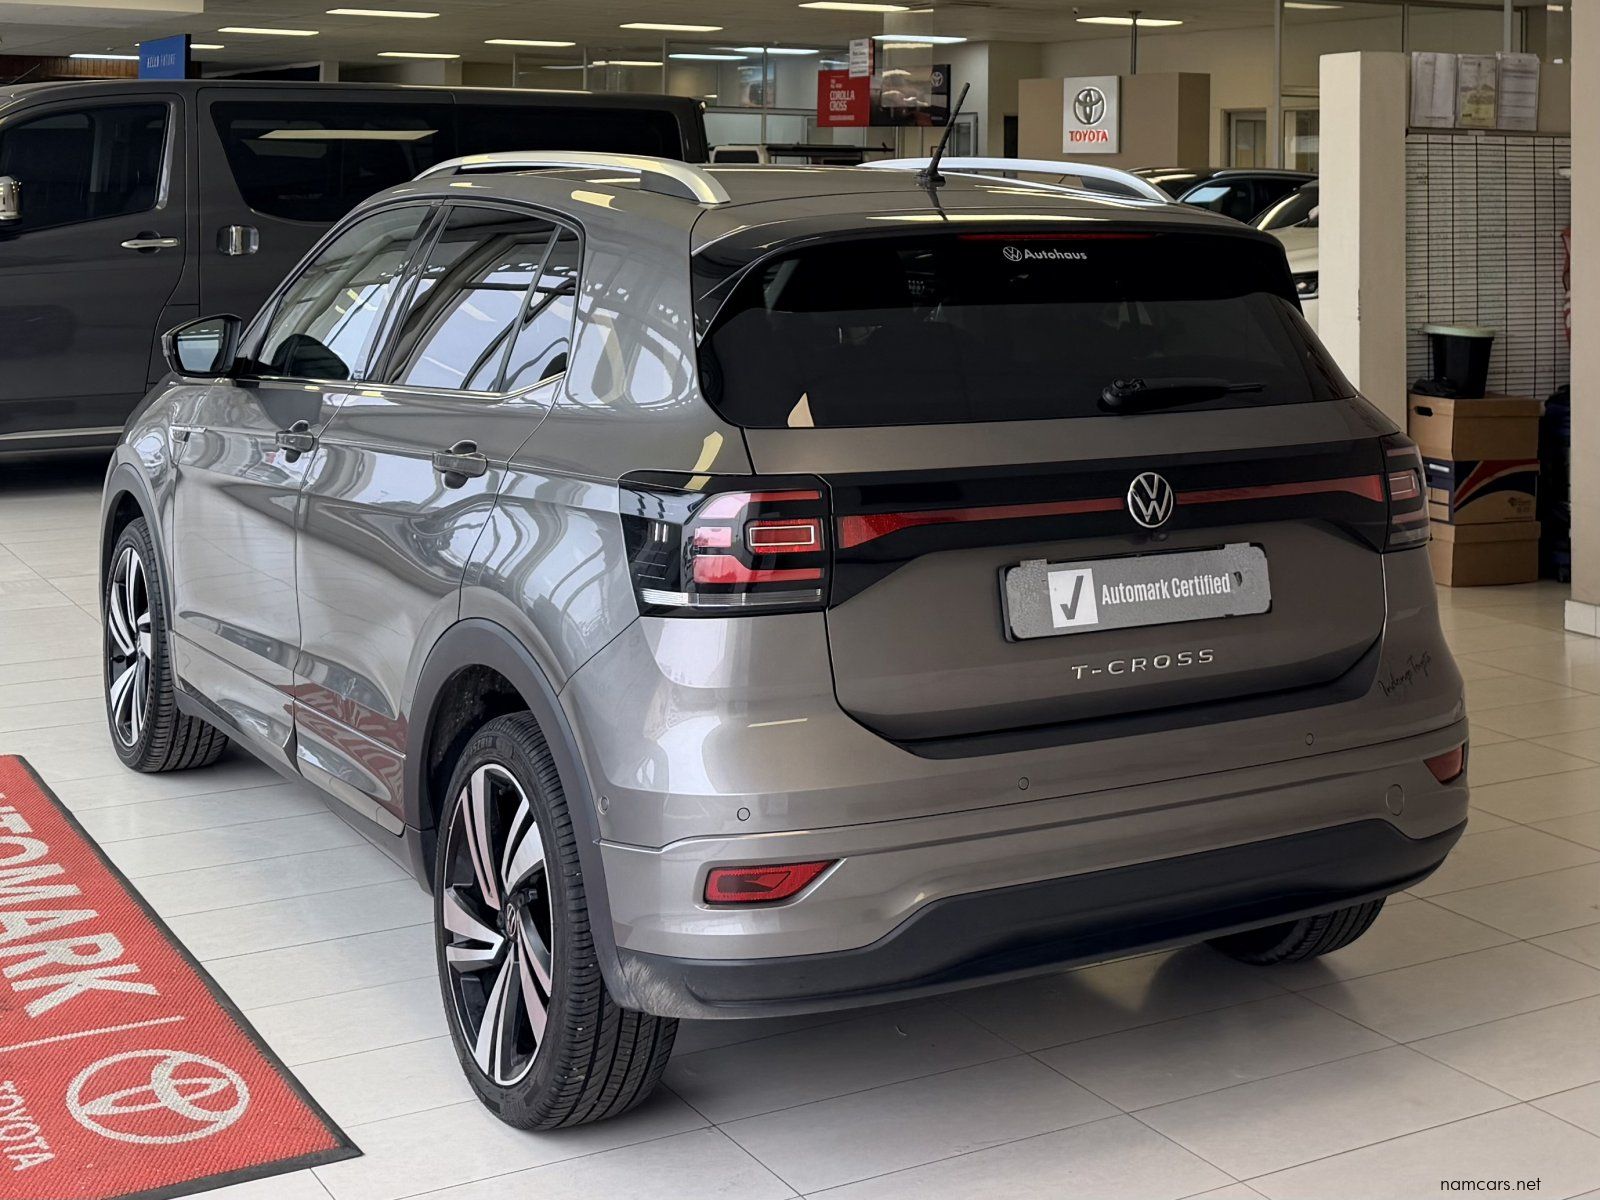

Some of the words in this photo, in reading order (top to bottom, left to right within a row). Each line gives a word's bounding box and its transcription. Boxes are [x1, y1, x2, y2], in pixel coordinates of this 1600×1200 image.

[830, 90, 855, 101] COROLLA
[830, 101, 847, 111] CROSS
[1069, 130, 1109, 142] TOYOTA
[1025, 248, 1088, 261] Autohaus
[1101, 579, 1171, 606] Automark
[1171, 573, 1231, 599] Certified
[1071, 649, 1215, 680] T-CROSS
